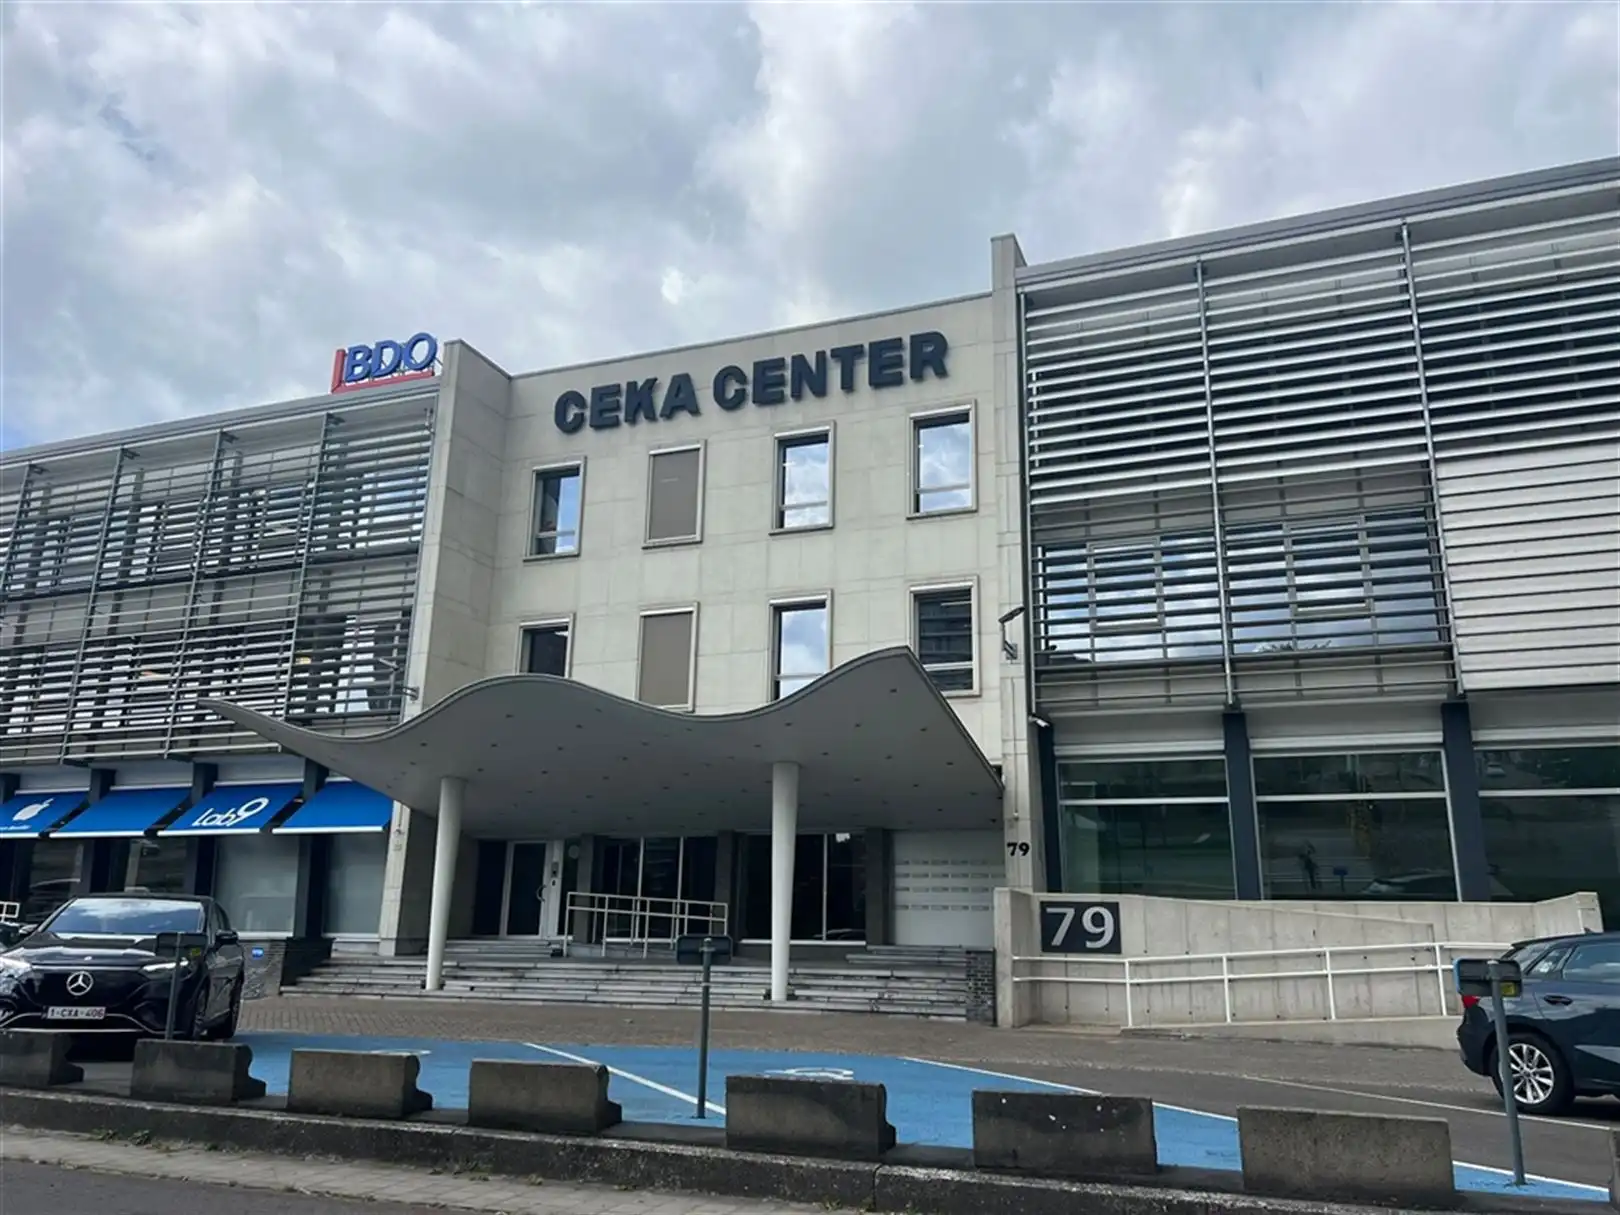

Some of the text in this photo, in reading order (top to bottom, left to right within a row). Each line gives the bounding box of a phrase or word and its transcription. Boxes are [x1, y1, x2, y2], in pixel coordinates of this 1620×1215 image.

[344, 332, 438, 382] BDO
[554, 331, 949, 434] CEKA CENTER
[191, 797, 269, 827] Lab9
[1006, 842, 1030, 856] 79
[1046, 906, 1115, 949] 79
